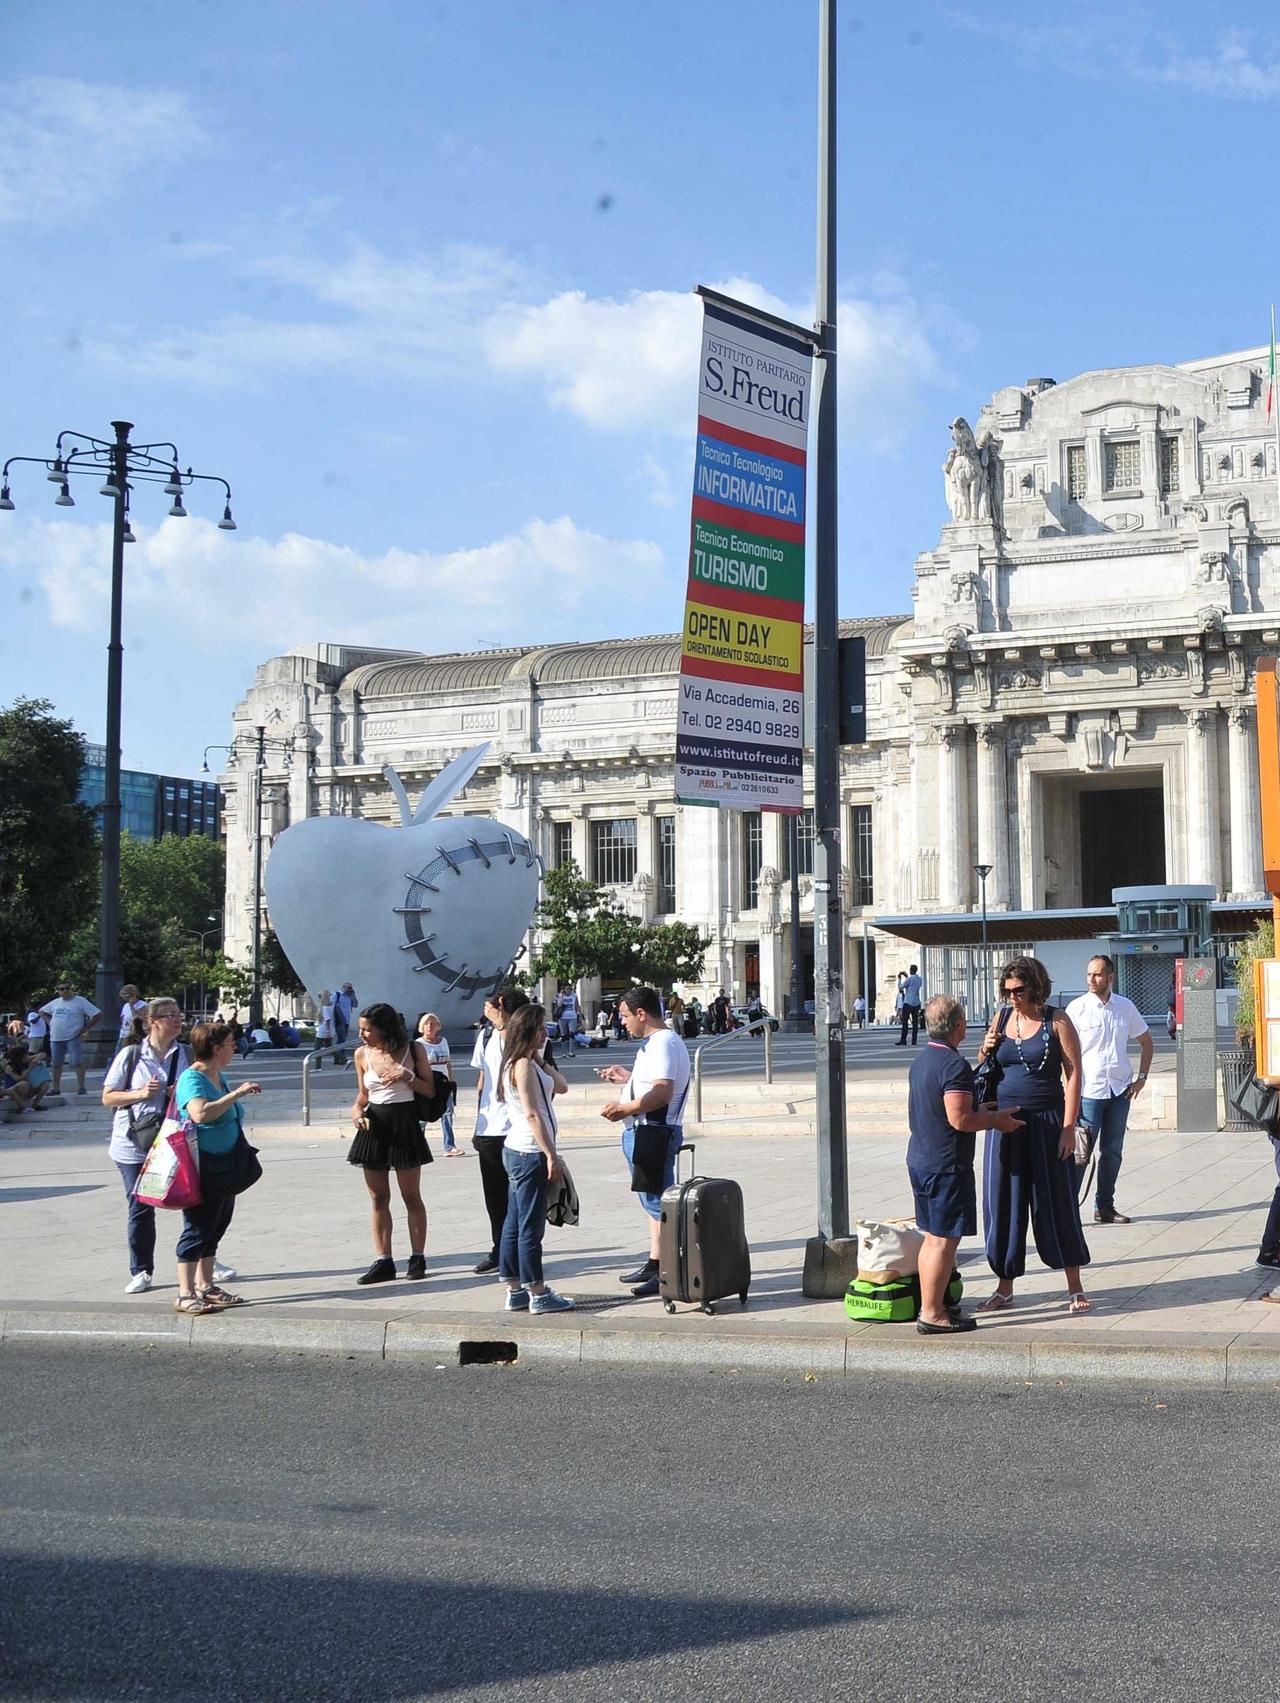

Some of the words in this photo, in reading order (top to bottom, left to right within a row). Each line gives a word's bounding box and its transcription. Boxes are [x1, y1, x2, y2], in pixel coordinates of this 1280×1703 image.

[708, 339, 754, 368] ISTITUTO
[756, 357, 806, 388] PARITARIO
[704, 357, 805, 424] S.Freud
[701, 440, 731, 466] Tecnico
[732, 452, 784, 482] Tecnologico
[698, 465, 797, 518] INFORMATICA
[695, 524, 728, 550] Tecnico
[730, 534, 784, 563] Economico
[693, 549, 768, 592] TURISMO
[688, 610, 731, 643] OPEN
[737, 621, 771, 650] DAY
[686, 640, 742, 662] ORIENTAMENTO
[744, 649, 789, 668] SCOLASTICO
[683, 684, 702, 702] Via
[704, 687, 779, 714] Accademia,
[782, 699, 800, 715] 26
[682, 711, 702, 727] Tel.
[705, 714, 723, 730] 02
[726, 716, 762, 735] 2940
[765, 721, 800, 739] 9829
[679, 744, 800, 767] www.istitutofreud.it
[679, 765, 717, 778] Spazio
[722, 769, 796, 785] Pubblicitario
[847, 1298, 884, 1311] HERBALIFE
